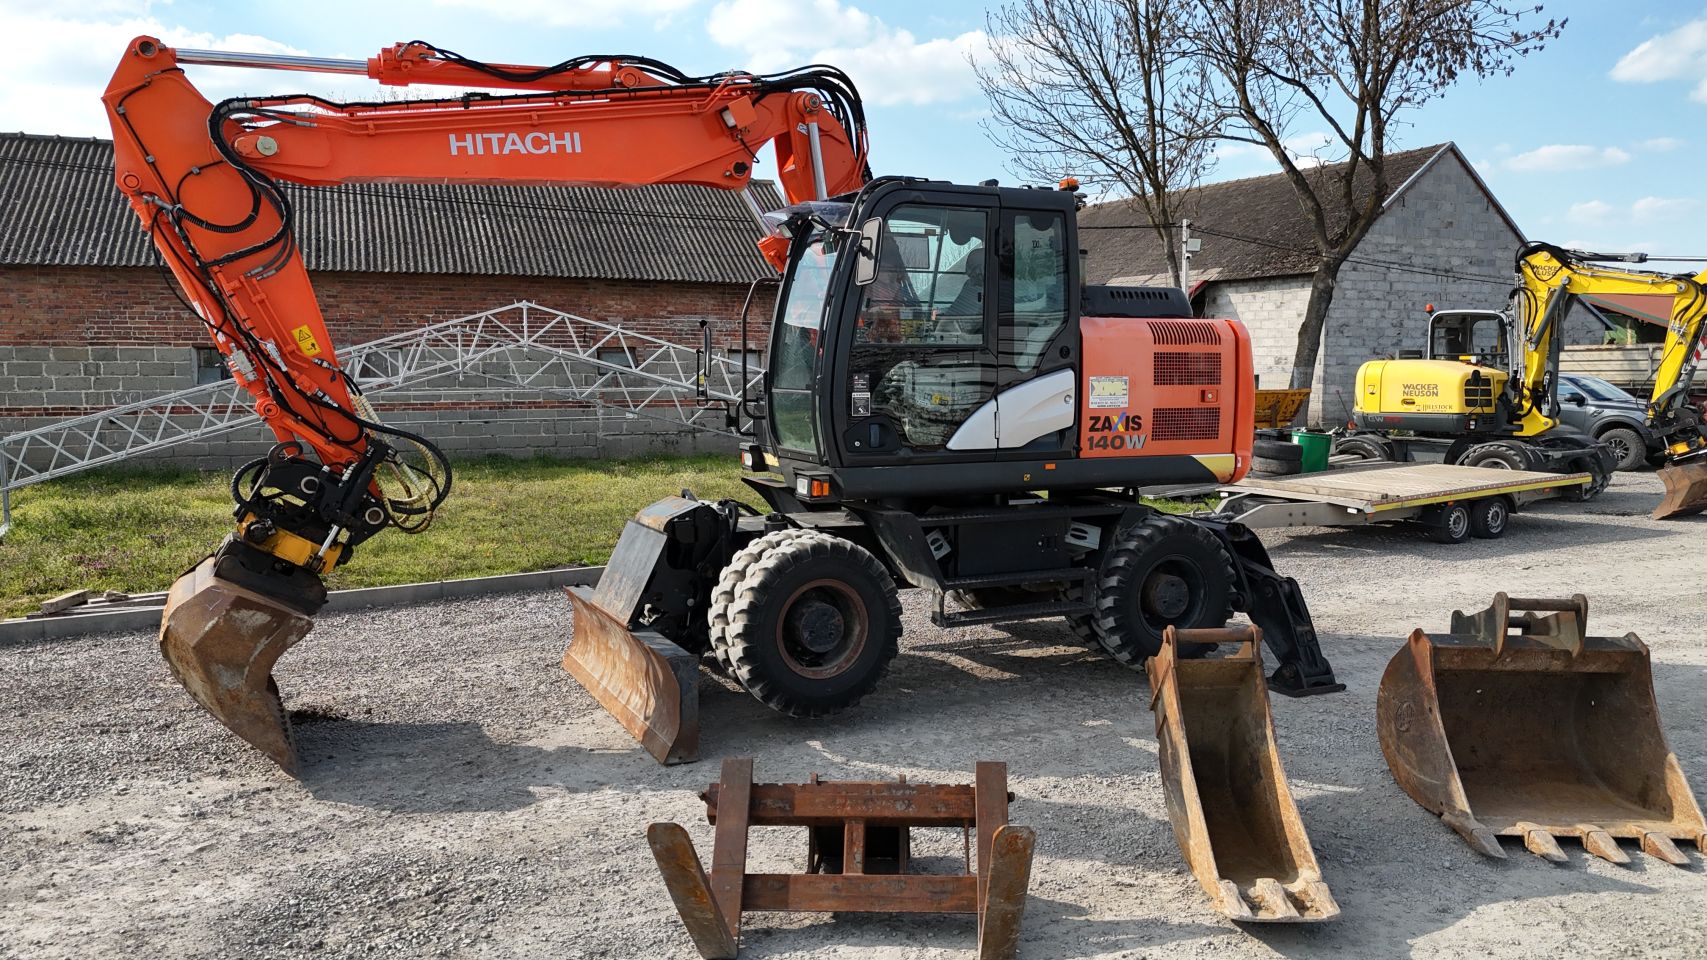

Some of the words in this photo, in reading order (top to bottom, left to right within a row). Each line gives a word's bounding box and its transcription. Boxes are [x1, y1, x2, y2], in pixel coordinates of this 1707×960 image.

[448, 131, 582, 156] HITACHI
[1402, 383, 1439, 391] WACKER
[1088, 411, 1142, 433] ZAXIS
[1087, 434, 1147, 451] 140W
